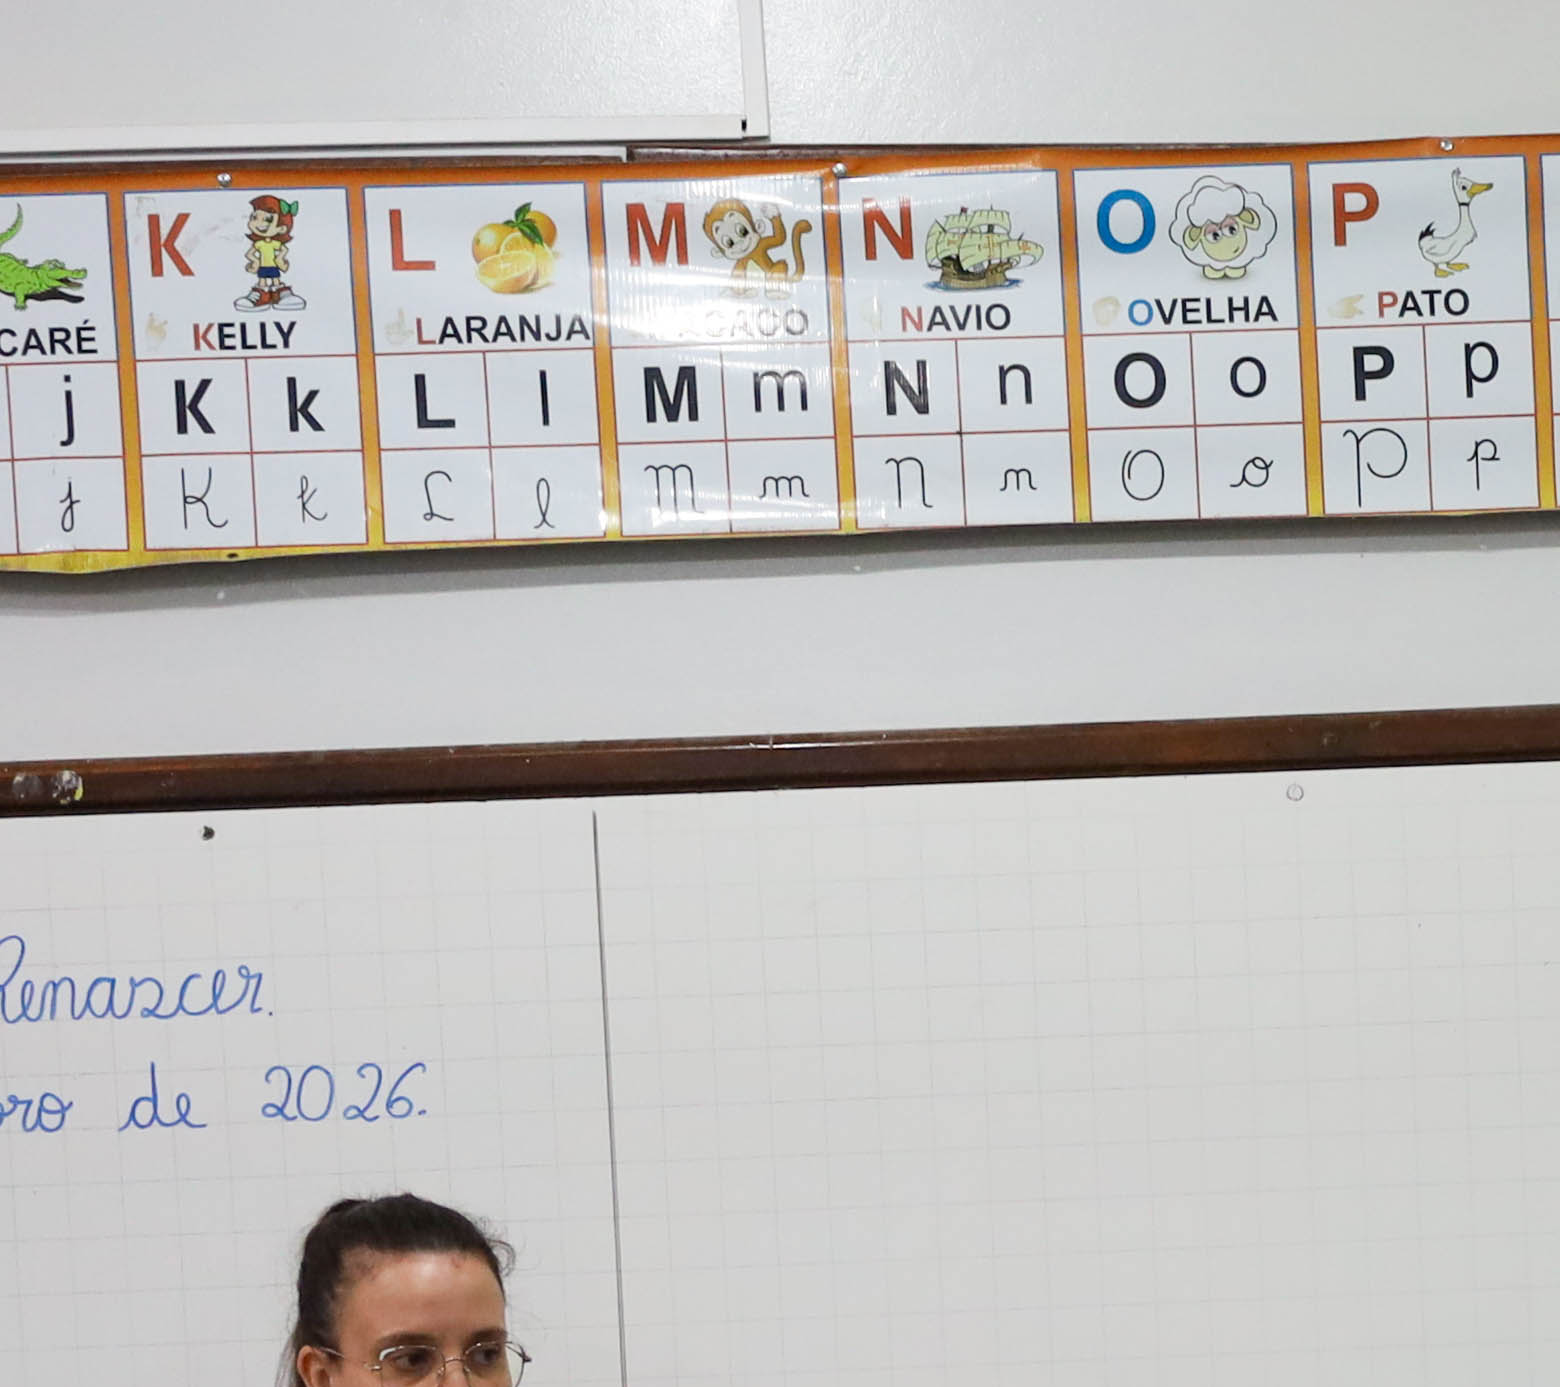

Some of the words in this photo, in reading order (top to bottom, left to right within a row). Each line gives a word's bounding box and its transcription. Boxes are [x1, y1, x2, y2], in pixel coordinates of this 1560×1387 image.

[899, 301, 1012, 336] NAVIO
[1126, 294, 1279, 328] OVELHA
[1376, 288, 1470, 320] PATO
[192, 319, 298, 353] KELLY
[413, 313, 591, 349] LARANJA
[117, 1060, 208, 1133] de
